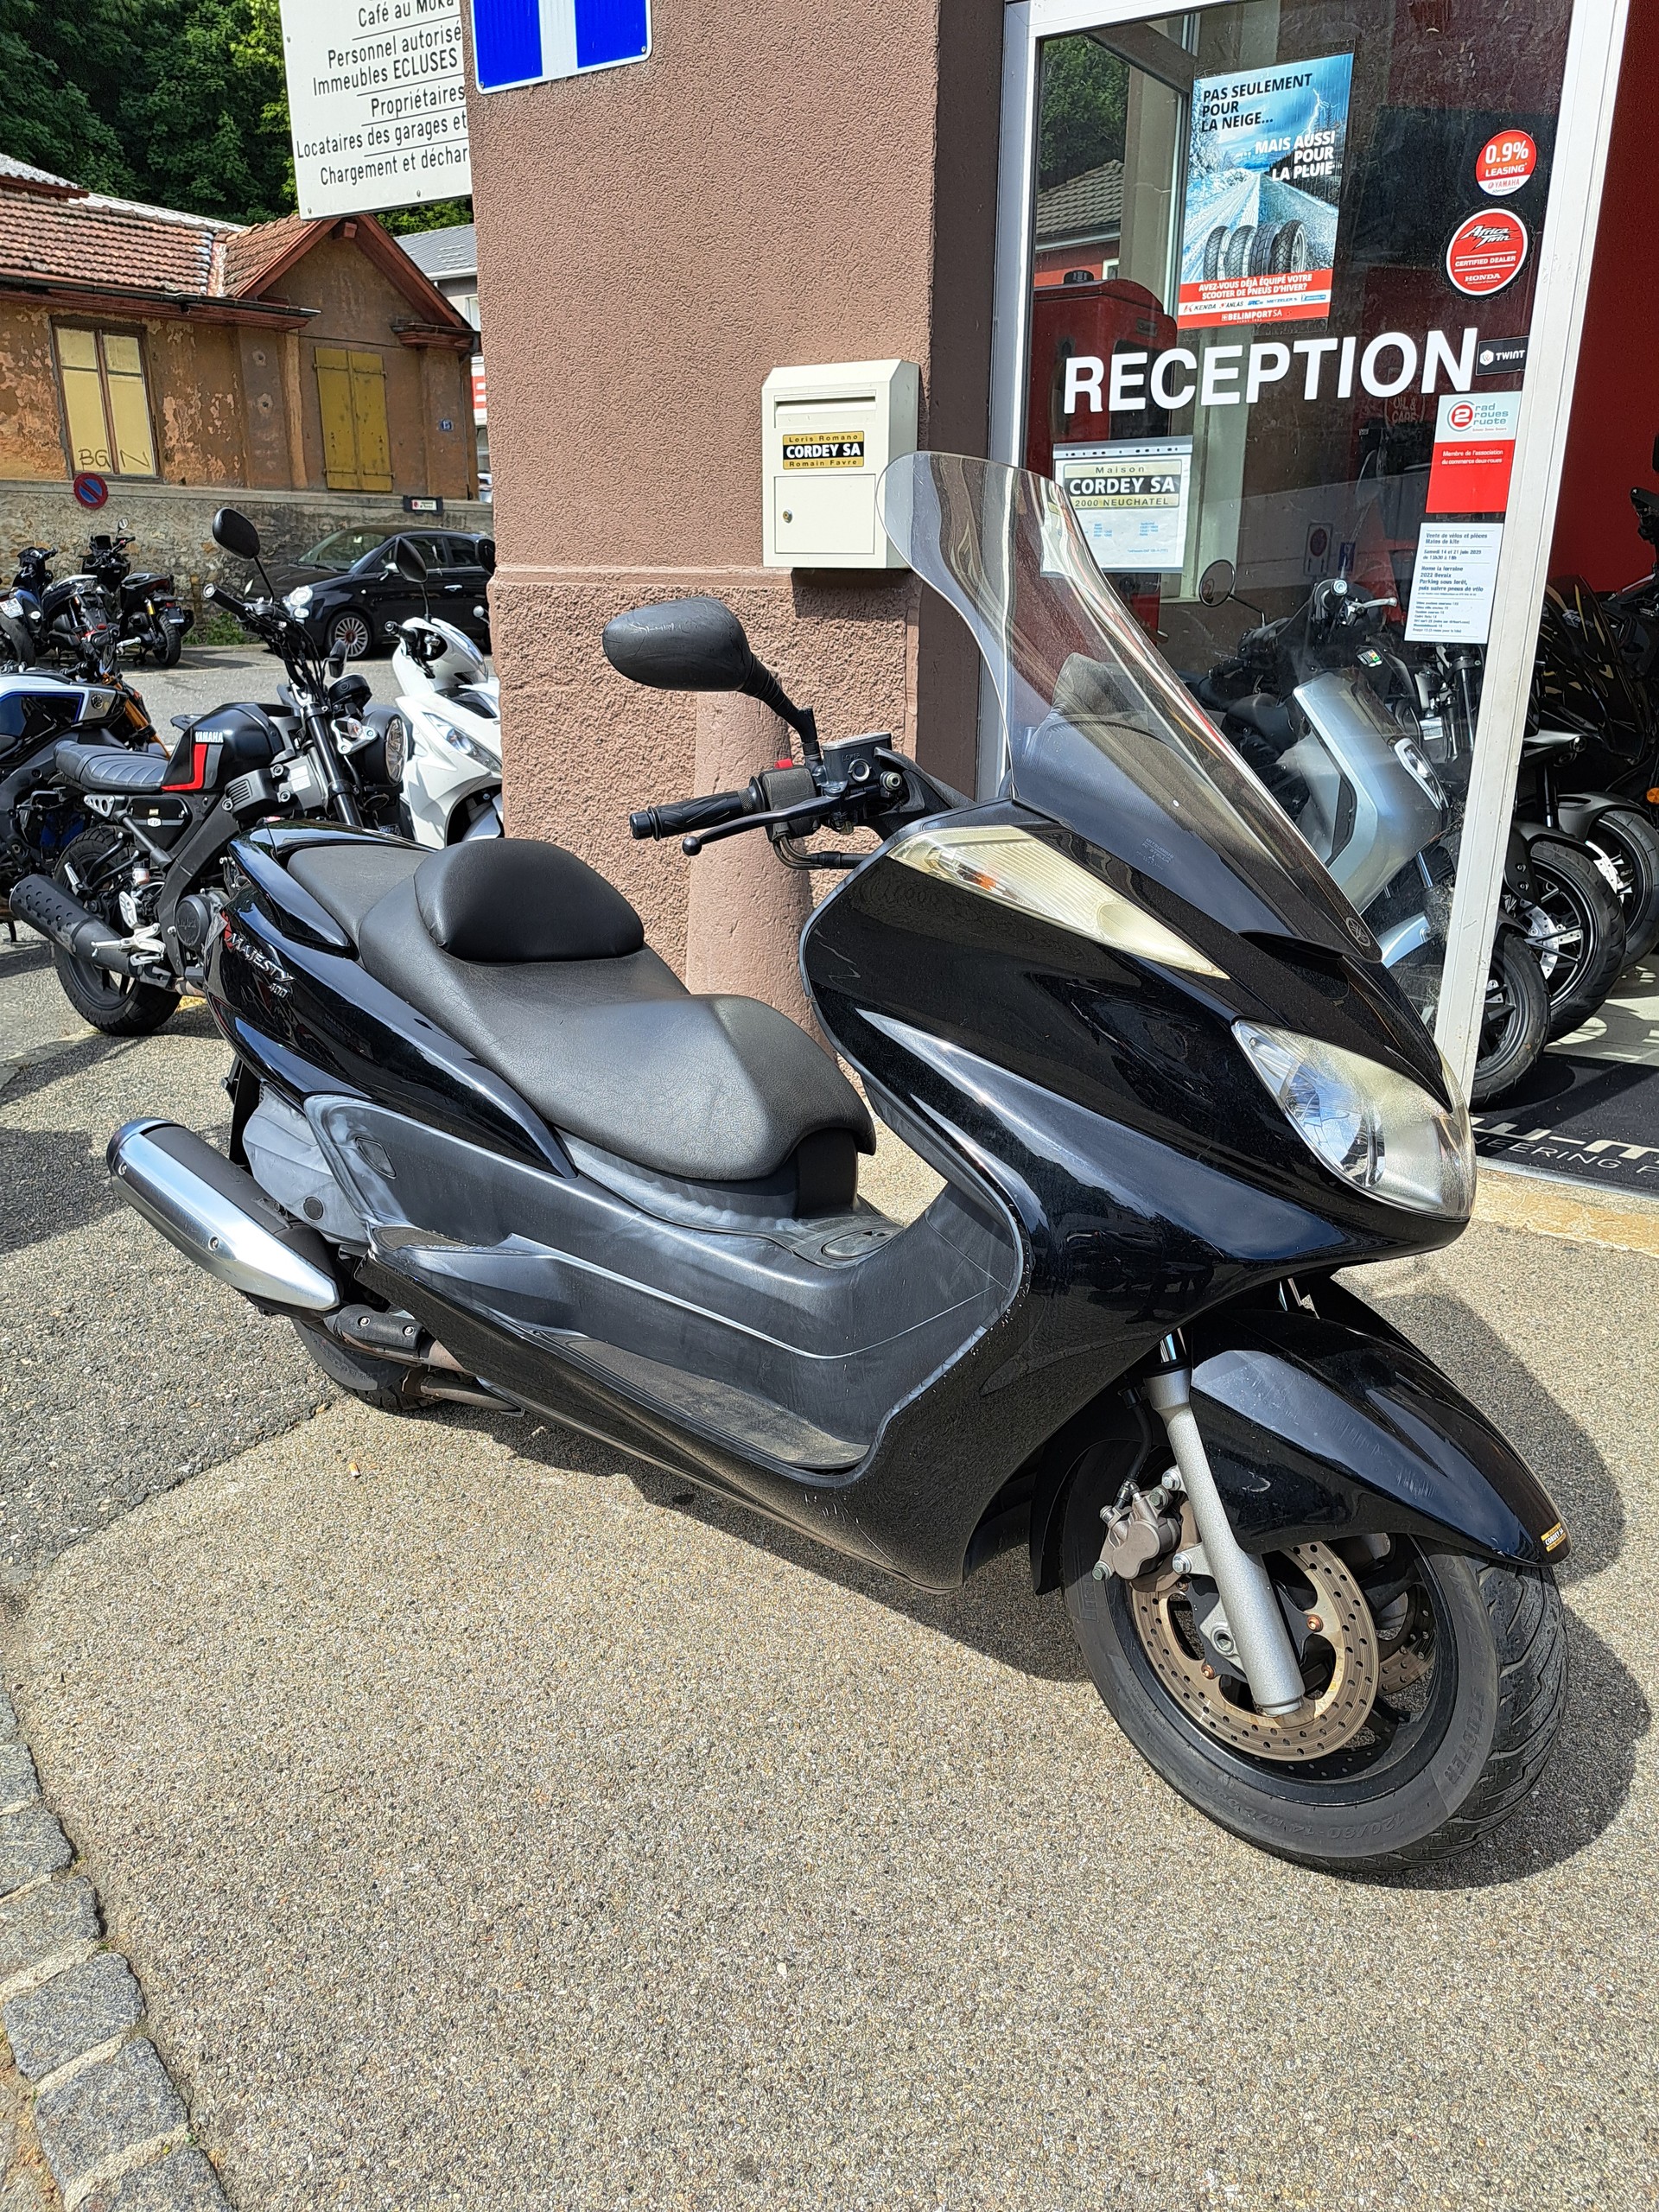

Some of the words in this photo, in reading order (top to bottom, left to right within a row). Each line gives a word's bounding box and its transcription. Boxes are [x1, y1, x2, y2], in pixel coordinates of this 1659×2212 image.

[358, 2, 389, 28] Café
[395, 3, 410, 19] au
[327, 35, 397, 68] Personnel
[402, 20, 462, 53] autorisé
[313, 66, 388, 96] Immeubles
[393, 47, 458, 79] ECLUSES
[1203, 86, 1228, 103] PAS
[1231, 73, 1313, 99] SEULEMENT
[371, 86, 466, 118] Propriétaires
[1202, 100, 1239, 118] POUR
[1201, 118, 1218, 132] LA
[1222, 111, 1274, 130] NEIGE...
[296, 133, 363, 158] Locataires
[367, 127, 390, 146] des
[395, 118, 448, 146] garages
[453, 110, 467, 131] et
[1255, 137, 1291, 156] MAIS
[1293, 130, 1336, 149] AUSSI
[1294, 147, 1334, 164] POUR
[1485, 140, 1529, 164] 0.9%
[321, 156, 397, 186] Chargement
[403, 152, 416, 172] et
[1272, 168, 1290, 182] LA
[1495, 178, 1520, 188] YAMAHA
[1459, 225, 1514, 240] Africa
[1474, 234, 1515, 249] Twin
[1455, 258, 1488, 267] CERTIFIED
[1198, 280, 1239, 292] AVEZ-VOUS
[1241, 277, 1258, 288] DÉJÀ
[1259, 275, 1287, 286] ÉQUIPÉ
[1287, 273, 1313, 283] VOTRE
[1465, 273, 1501, 282] HONDA
[1202, 290, 1236, 300] SCOOTER
[1236, 289, 1246, 297] DE
[1247, 286, 1273, 296] PNEUS
[1274, 283, 1307, 294] D'HIVER?
[1496, 350, 1526, 361] TWINT
[1064, 327, 1478, 414] RECEPTION
[1475, 403, 1496, 411] rad
[786, 443, 839, 458] CORDEY
[842, 443, 861, 456] SA
[1069, 477, 1144, 495] CORDEY
[1150, 476, 1175, 493] SA
[1103, 498, 1169, 506] NEUCHATEL
[195, 731, 224, 743] YAMAHA
[228, 933, 296, 982] MAJESTY
[269, 982, 289, 998] 400
